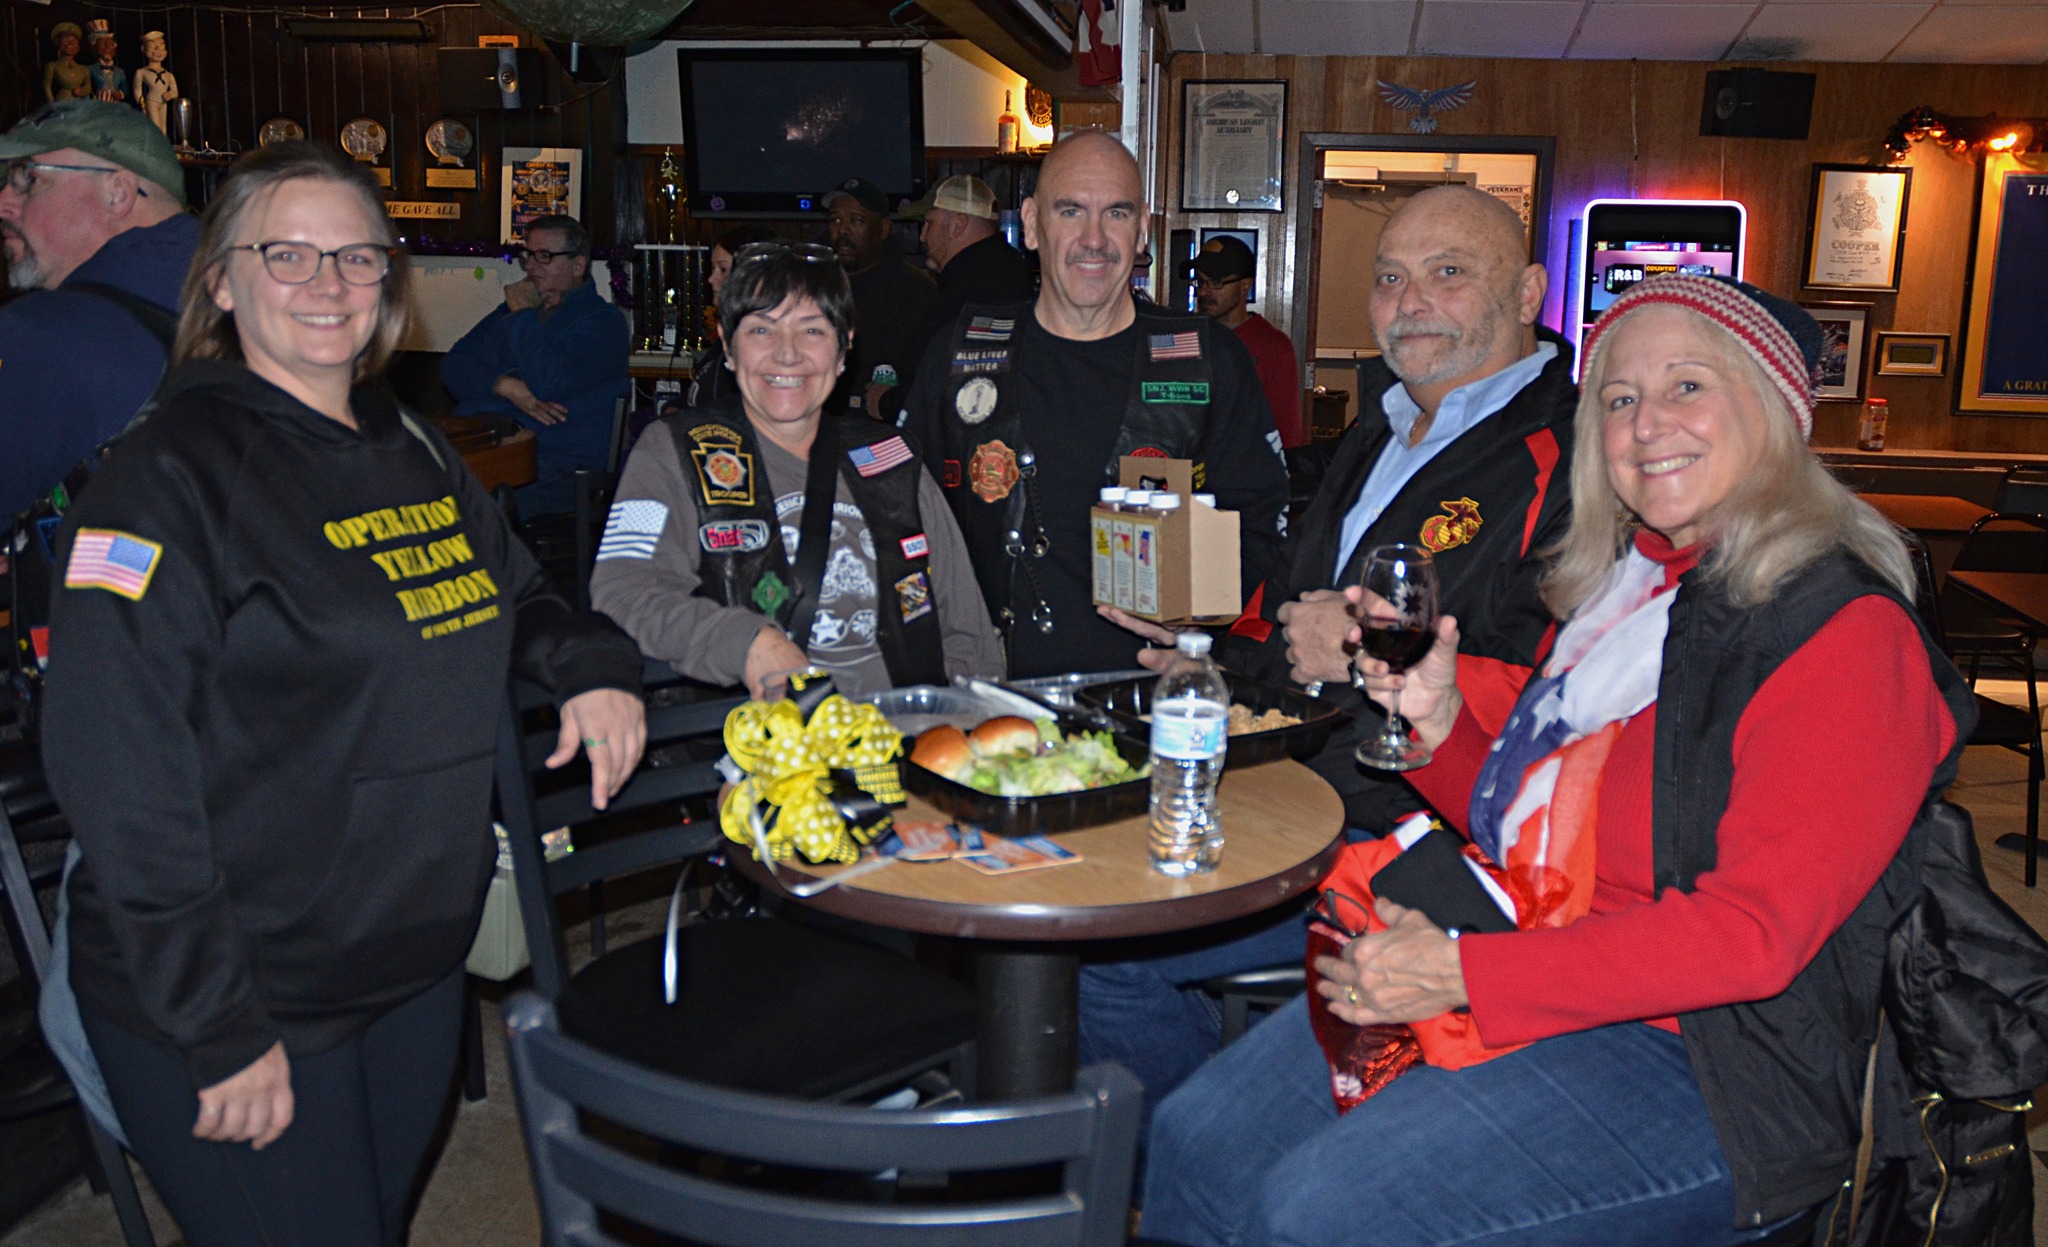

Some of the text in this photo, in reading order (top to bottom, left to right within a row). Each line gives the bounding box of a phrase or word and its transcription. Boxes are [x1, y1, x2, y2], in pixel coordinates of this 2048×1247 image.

[402, 204, 432, 215] GAVE
[433, 205, 456, 215] ALL
[1830, 240, 1881, 252] COOPER
[1613, 268, 1643, 282] R&B
[1645, 265, 1677, 273] COUNTRY
[956, 350, 1008, 360] BLUE LIVES
[963, 362, 998, 372] MATTER
[2003, 379, 2048, 391] A GRAT
[323, 495, 461, 550] OPERATION
[370, 533, 474, 581] YELLOW
[395, 568, 498, 622] RIBBON
[463, 604, 500, 628] JERSEY
